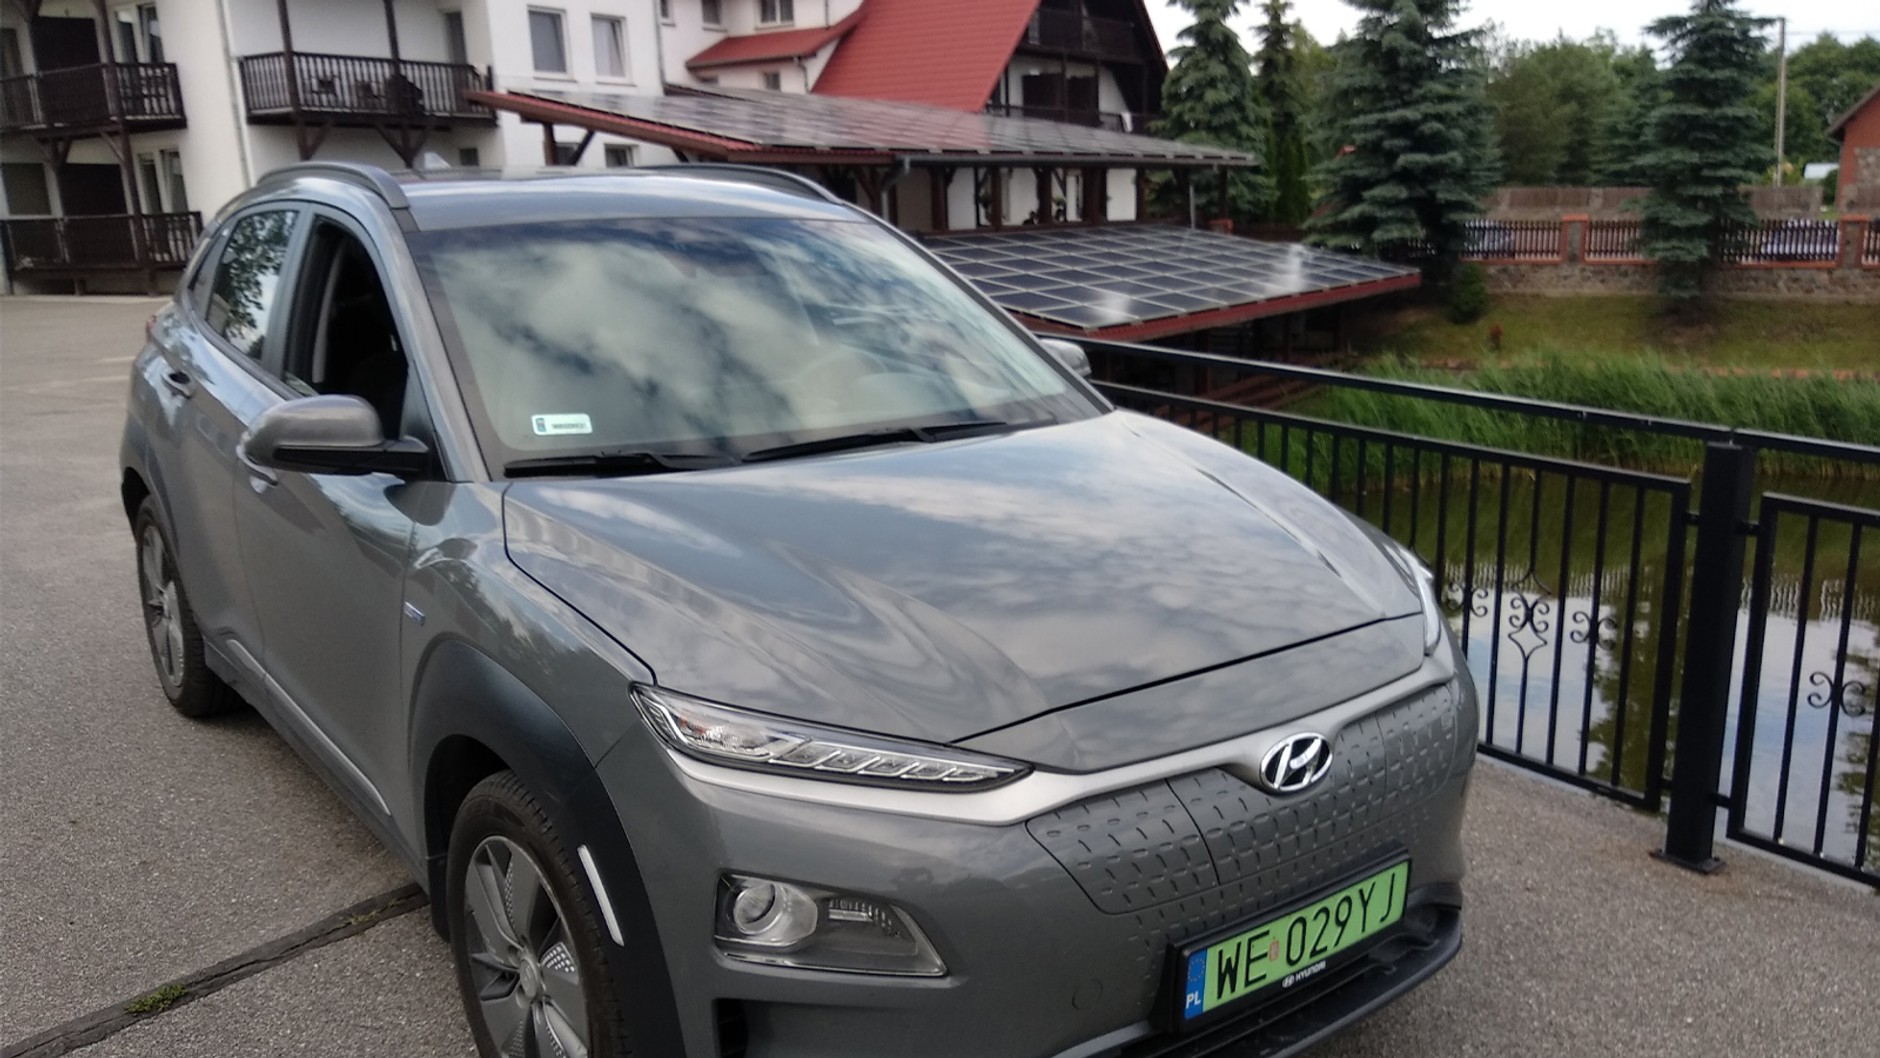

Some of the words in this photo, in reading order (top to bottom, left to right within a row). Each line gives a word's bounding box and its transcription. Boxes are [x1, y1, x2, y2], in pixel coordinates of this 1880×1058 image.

[1217, 929, 1270, 1000] WE
[1286, 872, 1396, 967] 029YJ
[1185, 990, 1201, 1010] PL
